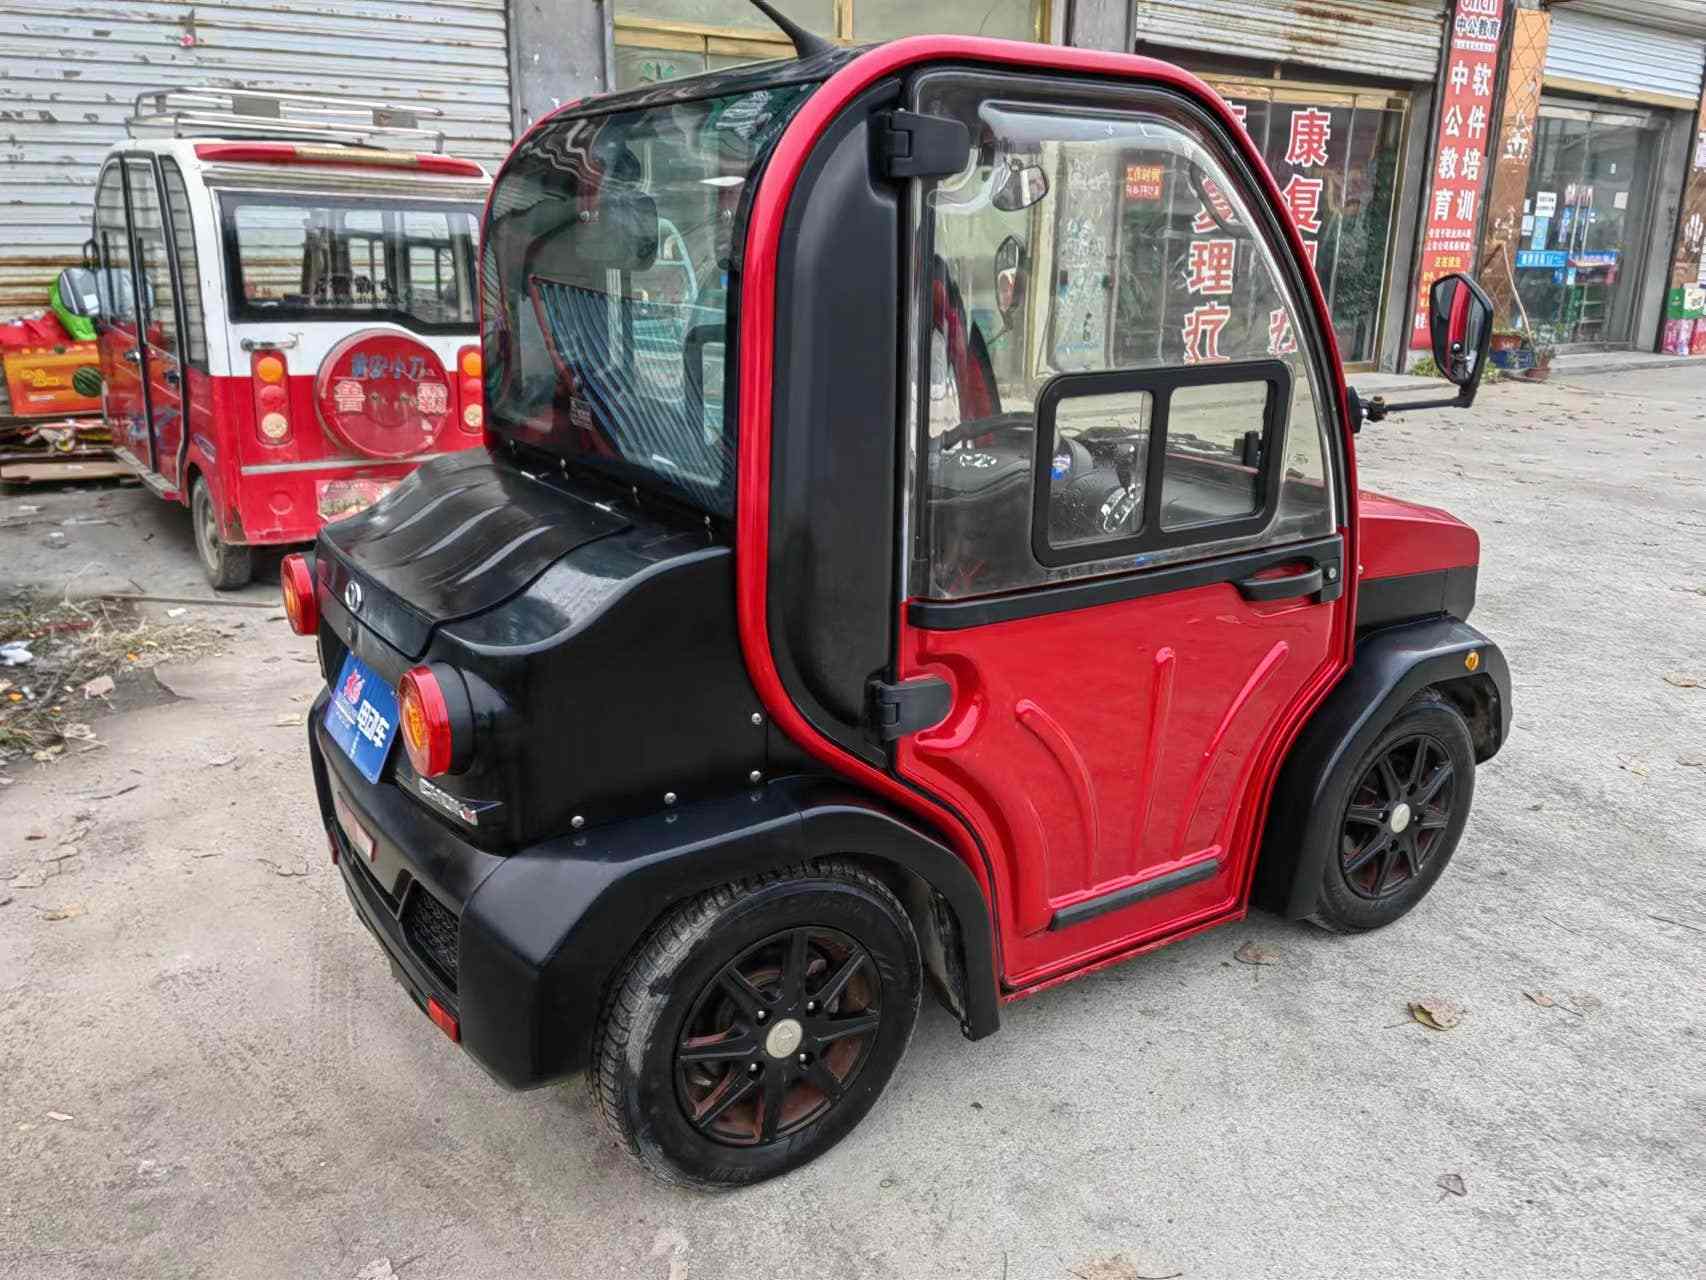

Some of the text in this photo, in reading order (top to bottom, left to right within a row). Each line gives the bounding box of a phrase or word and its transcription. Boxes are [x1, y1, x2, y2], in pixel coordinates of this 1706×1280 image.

[1455, 15, 1500, 40] 中公教育
[1434, 60, 1469, 222] 中公教育
[1456, 62, 1492, 222] 软件培训
